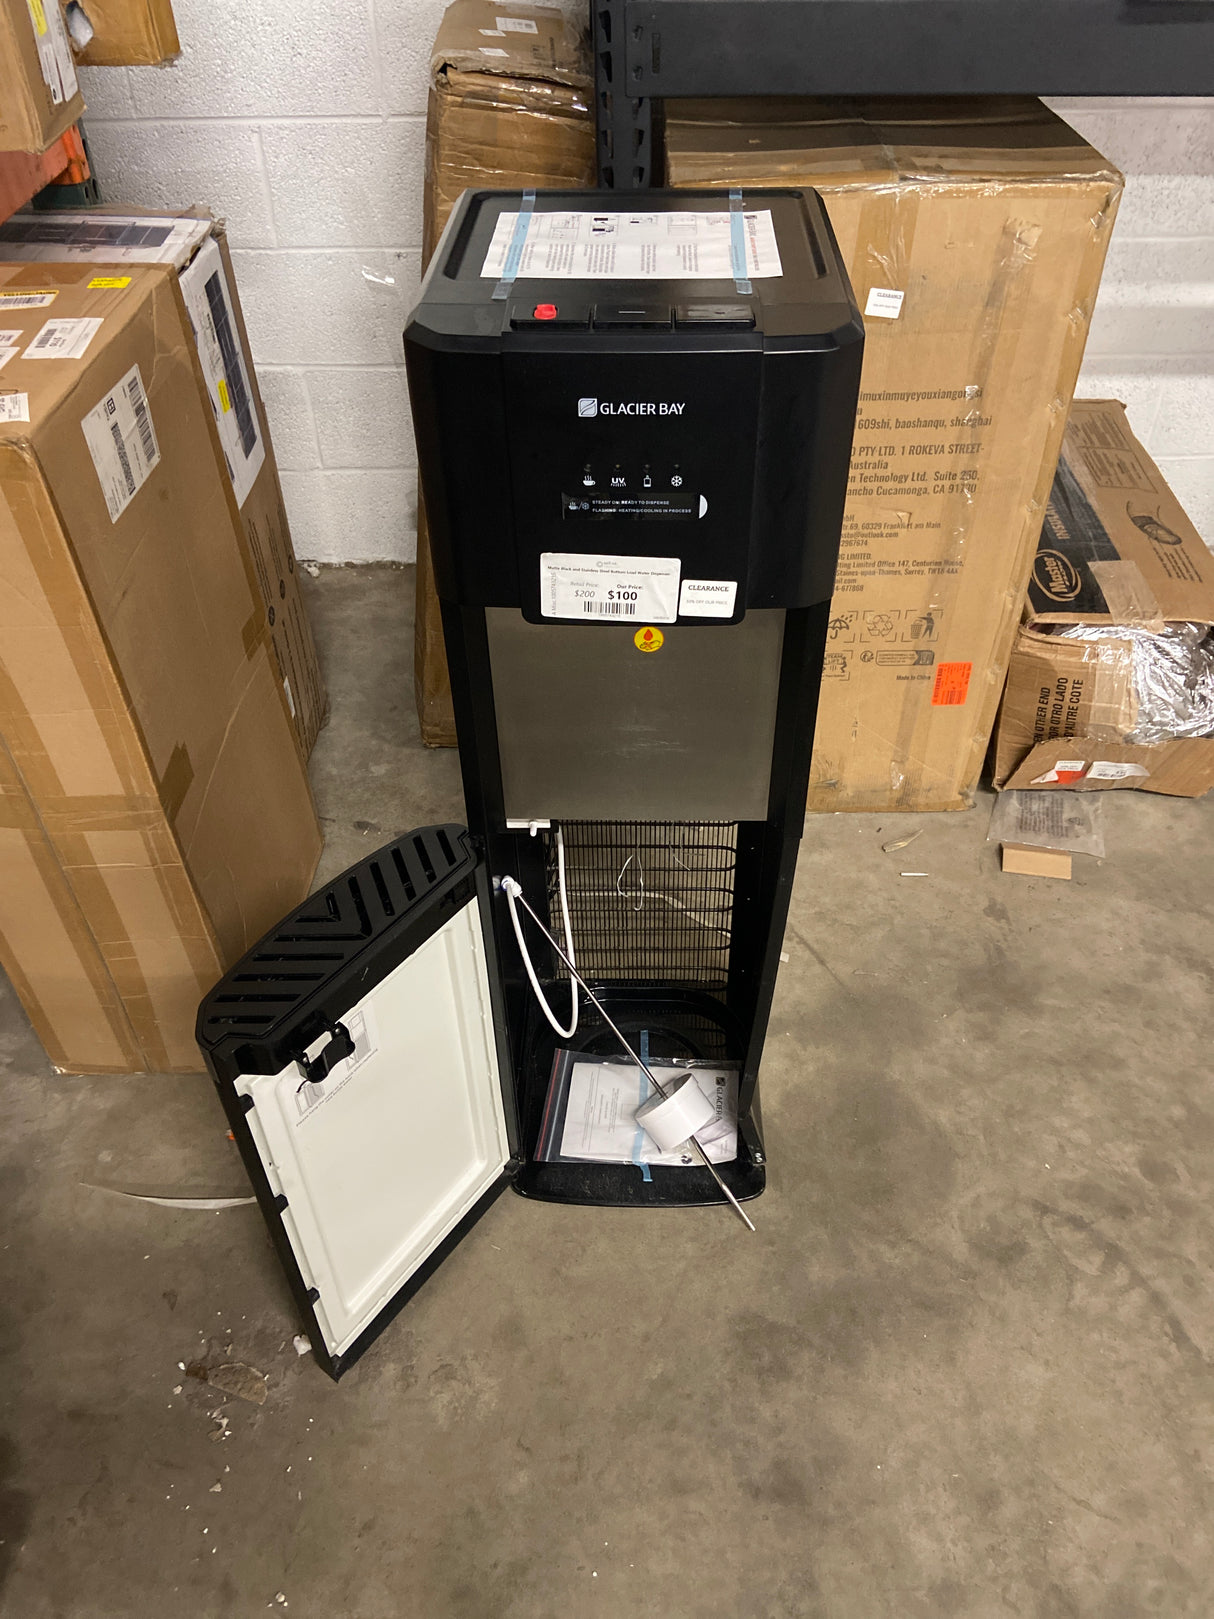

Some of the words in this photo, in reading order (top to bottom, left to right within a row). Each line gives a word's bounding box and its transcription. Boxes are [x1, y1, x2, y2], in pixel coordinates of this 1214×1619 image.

[600, 402, 656, 415] GLACIER
[659, 402, 685, 415] BAY
[859, 446, 876, 456] PTY
[878, 446, 896, 456] LTD.
[901, 445, 906, 456] 1
[908, 444, 945, 455] ROKEVA
[859, 473, 909, 484] Technology
[911, 472, 928, 482] Ltd.
[933, 471, 958, 482] Suite
[933, 484, 945, 494] CA
[1043, 556, 1068, 593] Master
[574, 589, 596, 598] $200
[607, 589, 638, 601] $100
[688, 584, 730, 592] CLEARANCE
[1038, 687, 1051, 705] END
[1054, 677, 1069, 702] LADO
[1069, 679, 1084, 704] COTE
[1034, 706, 1049, 732] OTHER
[1050, 703, 1064, 725] OTRO
[716, 1086, 724, 1115] GLACIER
